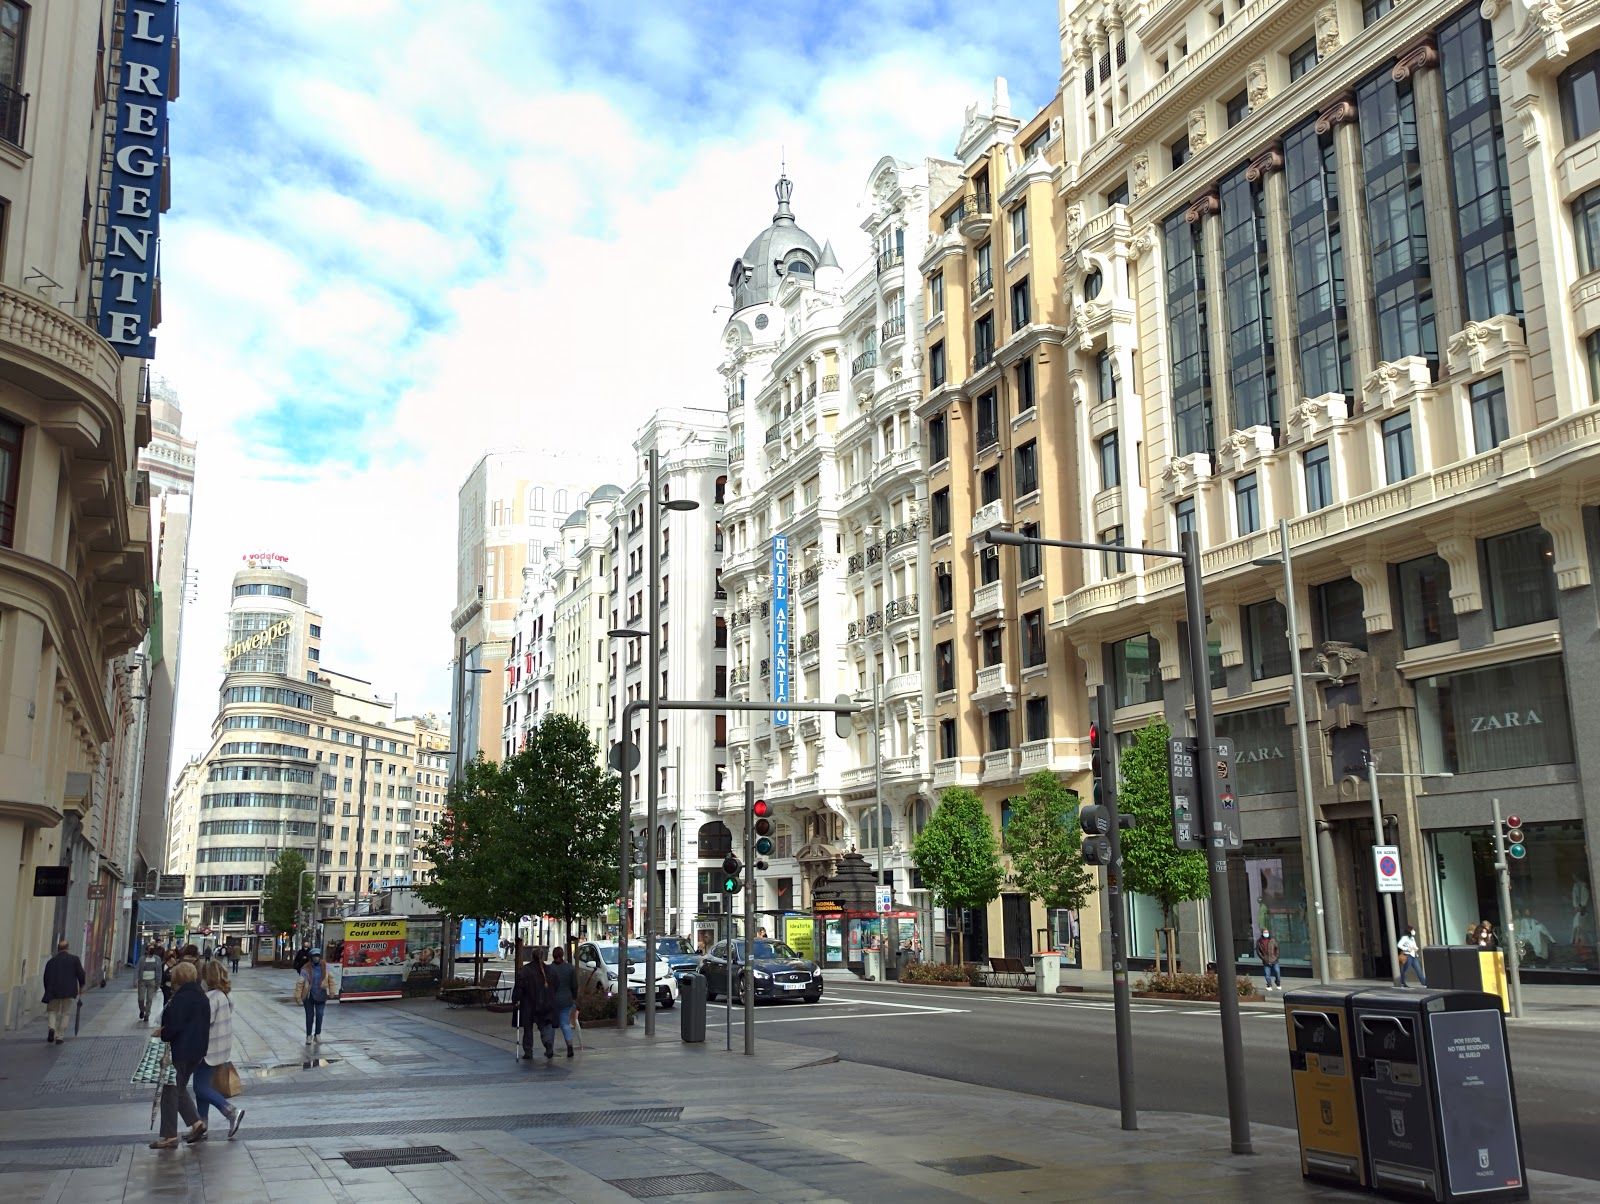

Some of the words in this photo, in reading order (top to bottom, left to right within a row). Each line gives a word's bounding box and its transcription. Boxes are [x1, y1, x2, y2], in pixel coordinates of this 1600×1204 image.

[131, 0, 167, 43] L
[106, 61, 163, 346] REGENTE
[249, 552, 289, 563] vodafone
[775, 538, 786, 600] HOTEL
[1471, 709, 1543, 732] ZARA
[1234, 746, 1284, 764] ZARA
